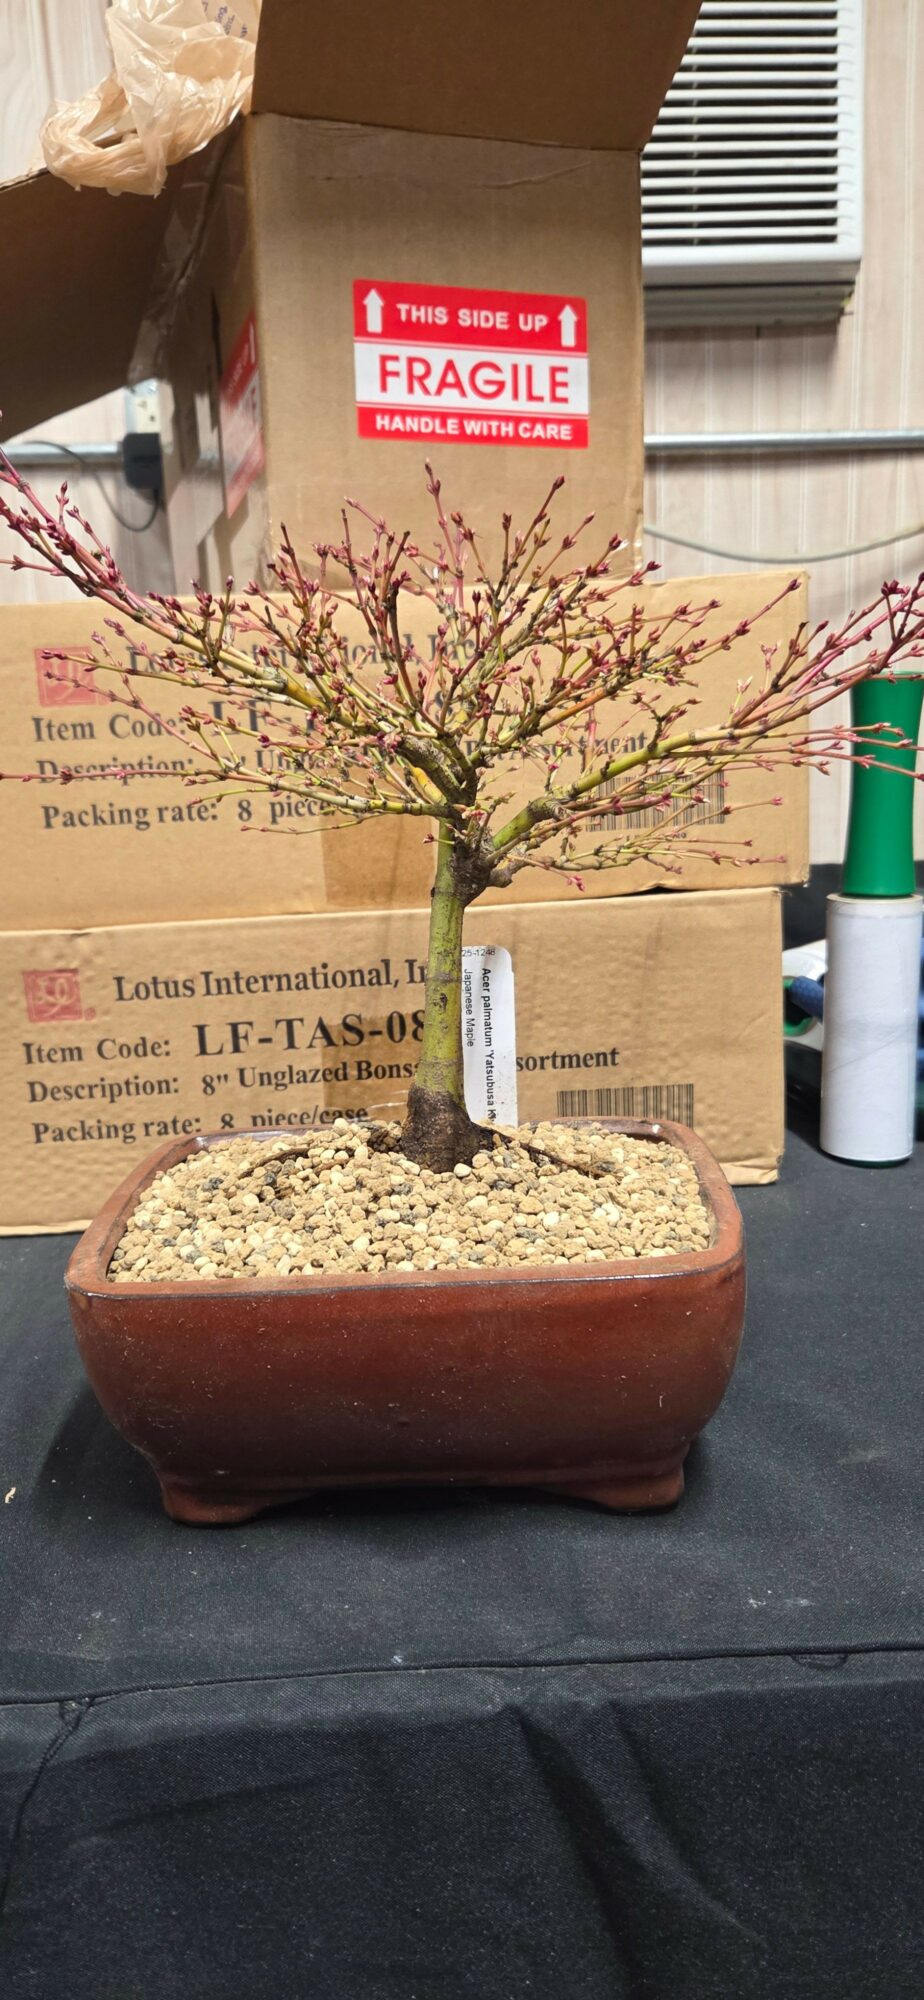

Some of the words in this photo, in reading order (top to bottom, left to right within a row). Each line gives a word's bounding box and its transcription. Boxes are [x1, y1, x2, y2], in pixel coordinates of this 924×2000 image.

[396, 303, 449, 325] THIS
[457, 308, 510, 330] SIDE
[518, 313, 549, 332] UP
[379, 354, 570, 405] FRAGILE
[375, 414, 460, 435] HANDLE
[463, 419, 515, 438] WITH
[518, 423, 573, 441] CARE
[32, 716, 96, 742] Item
[108, 712, 186, 739] Code:
[36, 754, 194, 787] Description:
[41, 802, 151, 831] Packing
[157, 801, 218, 824] rate:
[237, 799, 252, 822] 8
[113, 976, 196, 1001] Lotus
[201, 959, 399, 997] International,
[463, 968, 473, 1015] Japanese
[481, 967, 491, 992] Acer
[465, 1018, 476, 1047] Maple
[481, 995, 494, 1047] palmatum
[22, 1042, 84, 1065] Item
[97, 1036, 171, 1060] Code:
[27, 1075, 180, 1104] Description:
[202, 1073, 229, 1096] 8"
[237, 1064, 348, 1091] Unglazed
[354, 1060, 419, 1081] Bons
[516, 1047, 620, 1072] sortment
[32, 1119, 136, 1144] Packing
[143, 1115, 202, 1137] rate:
